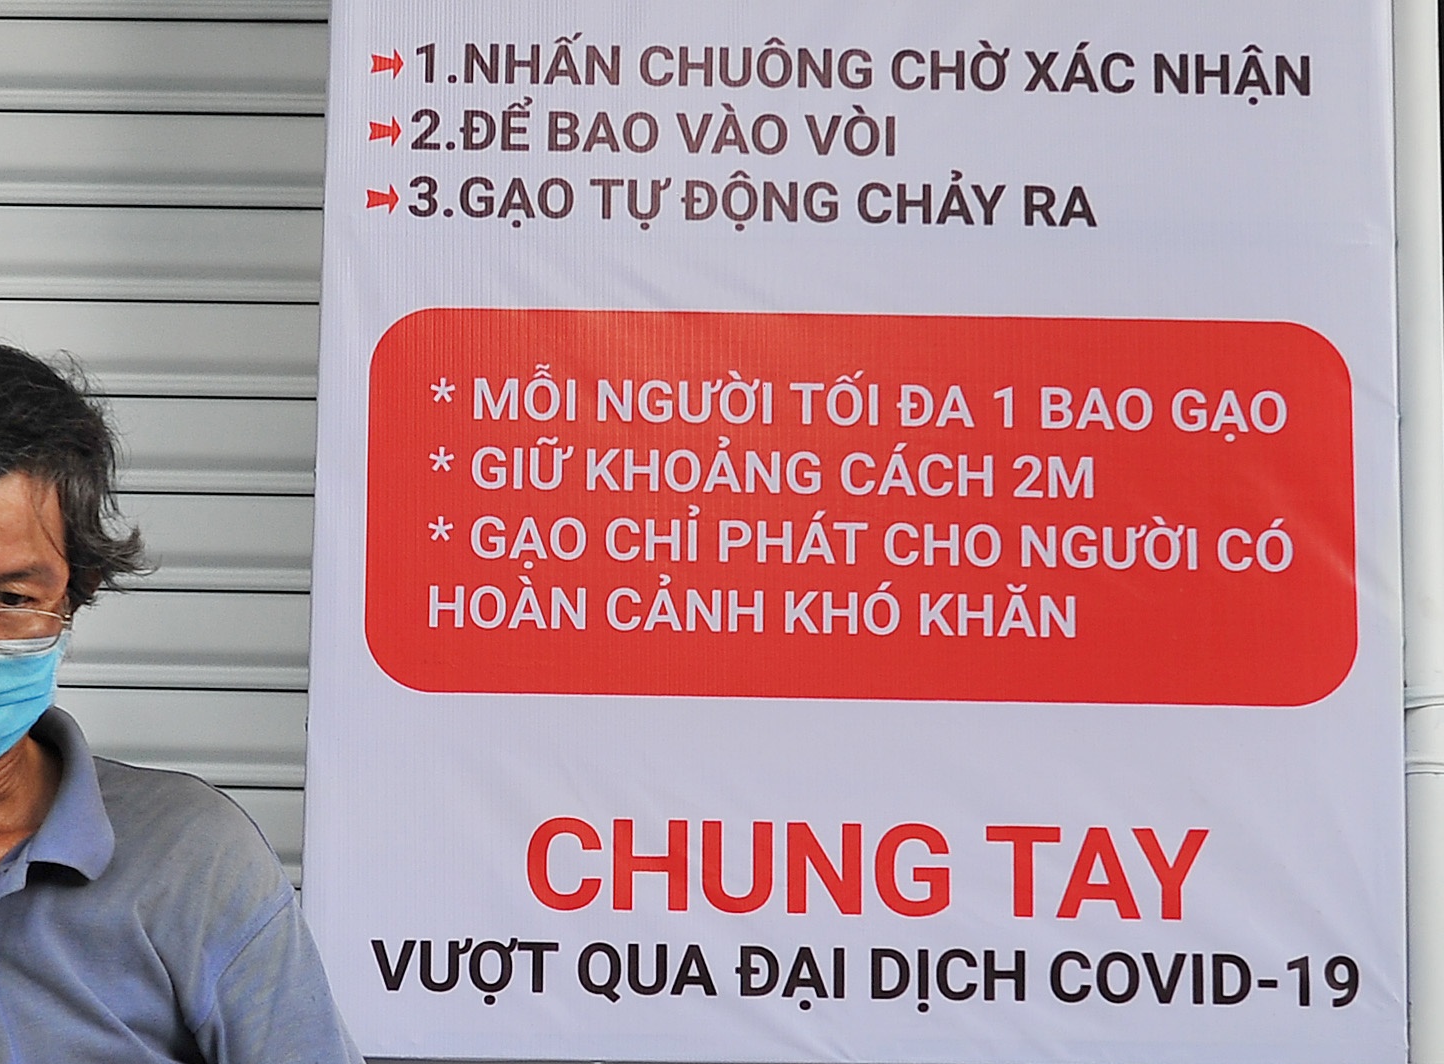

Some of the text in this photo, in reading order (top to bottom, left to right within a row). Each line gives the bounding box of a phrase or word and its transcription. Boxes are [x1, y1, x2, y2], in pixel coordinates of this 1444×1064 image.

[416, 32, 1311, 106] 1.NHẤN CHUÔNG CHỜ XÁC NHẬN
[411, 95, 896, 157] 2.ĐỂ BAO VÀO VÒI
[408, 169, 1098, 232] 3.GẠO TỰ ĐỘNG CHẢY RA
[473, 363, 1287, 442] MỖI NGƯỜI TỐI ĐA 1 BAO GẠO
[471, 435, 1094, 499] GIỮ KHOẢNG CÁCH 2M
[470, 504, 1293, 573] GẠO CHỈ PHÁT CHO NGƯỜI CÓ
[428, 573, 1076, 638] HOÀN CẢNH KHÓ KHĂN
[527, 816, 1210, 921] CHUNG TAY
[370, 937, 1360, 1014] VƯỢT QUA ĐẠI DỊCH COVID-19
